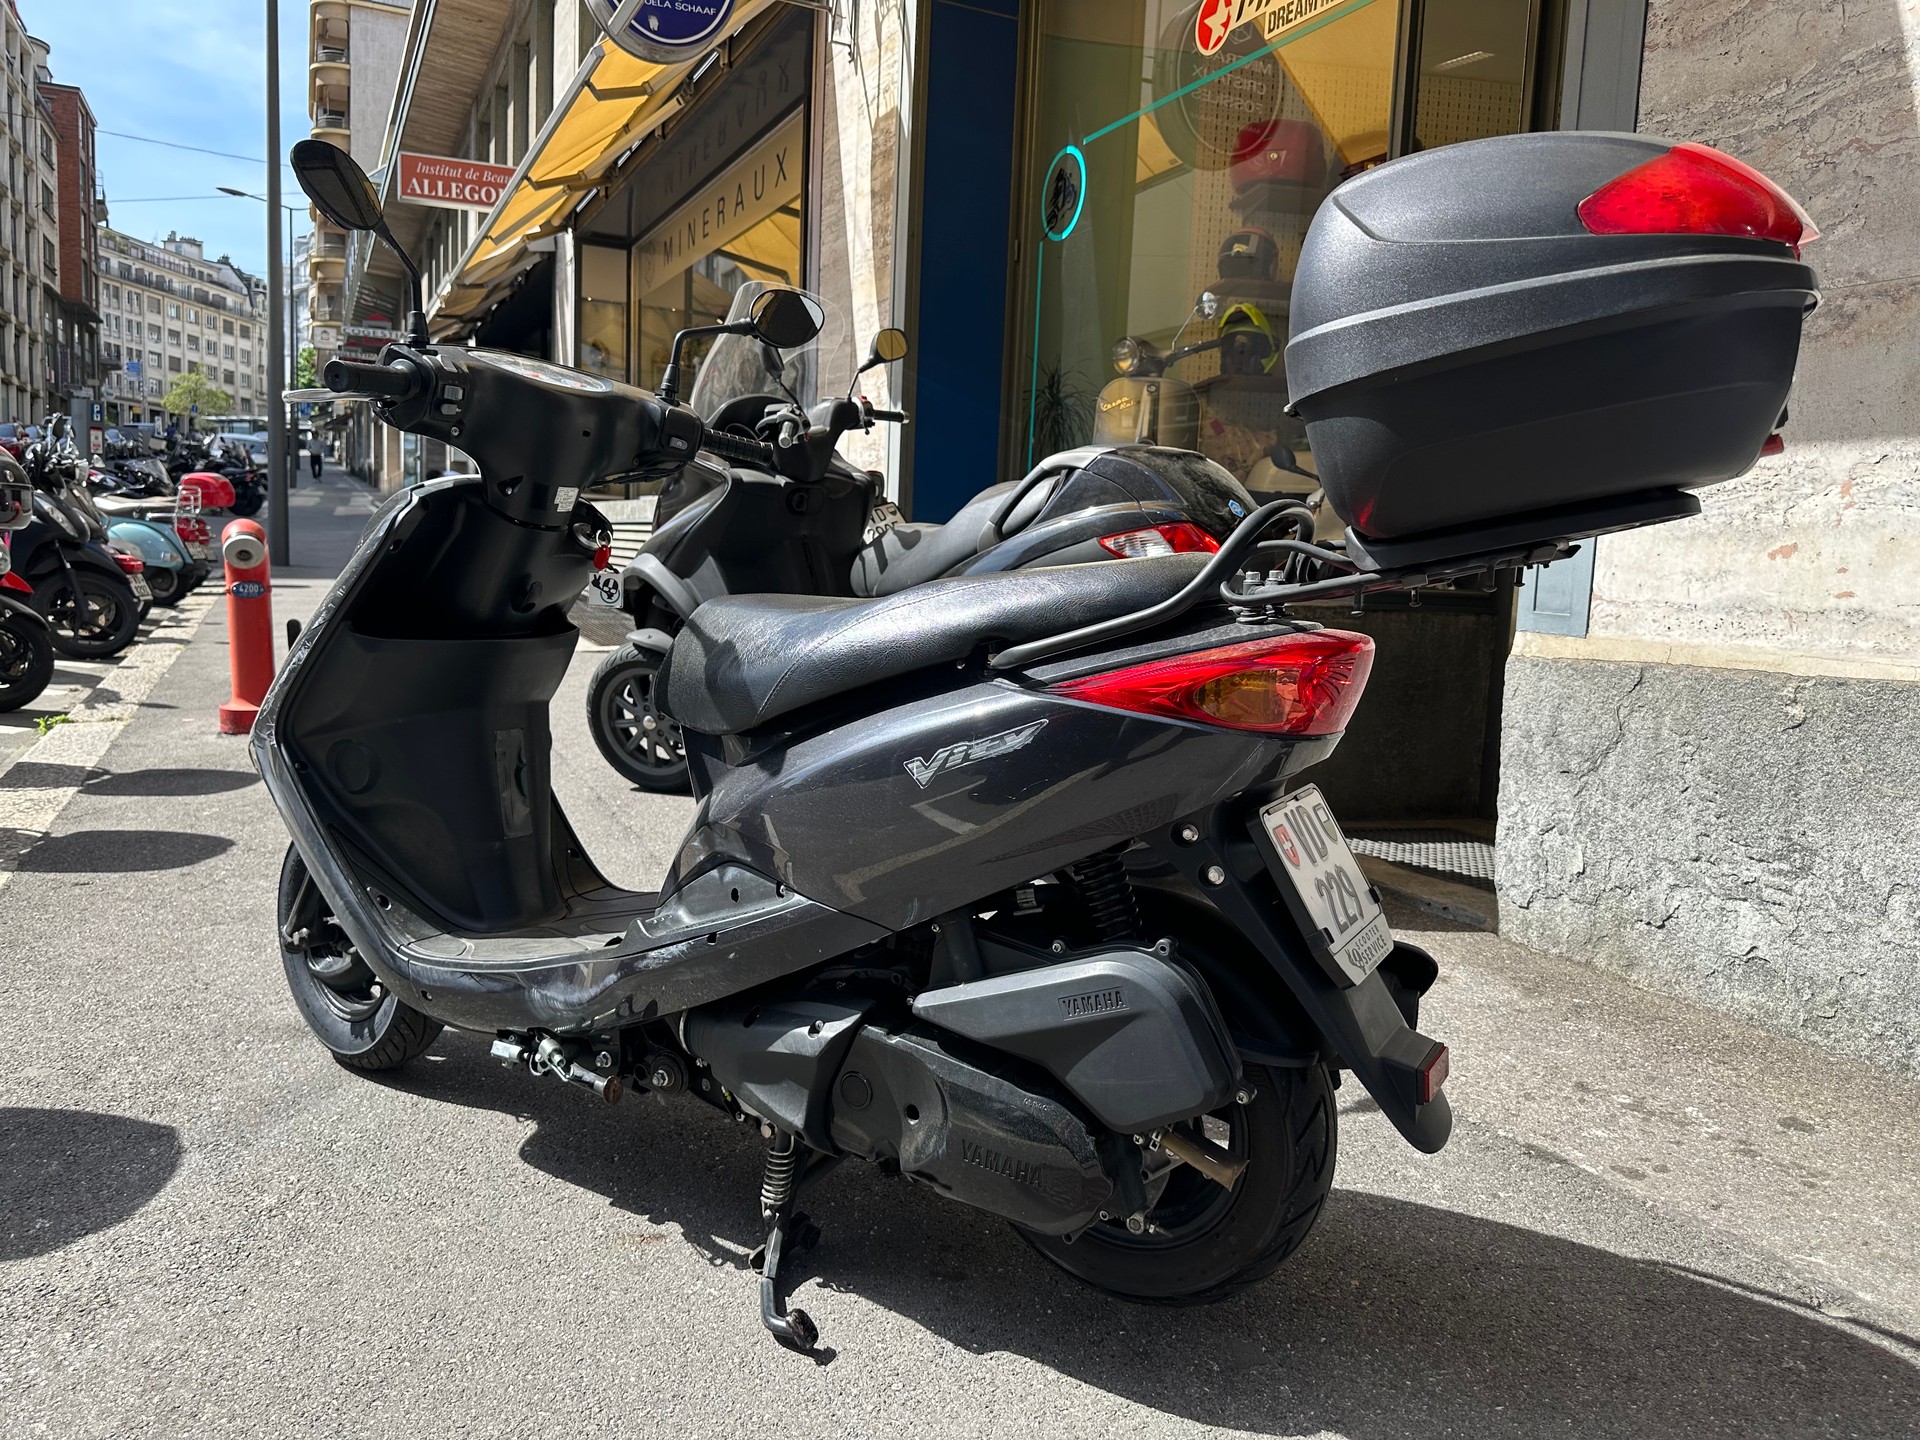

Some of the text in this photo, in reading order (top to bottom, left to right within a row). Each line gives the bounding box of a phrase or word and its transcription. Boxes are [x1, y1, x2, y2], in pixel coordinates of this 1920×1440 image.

[675, 2, 717, 16] SCHAAF
[1267, 0, 1318, 34] DREAM
[416, 162, 462, 178] Institut
[465, 168, 480, 181] de
[407, 177, 505, 204] ALLEGO
[663, 147, 788, 267] MINERAUX
[239, 583, 259, 593] 4200
[1284, 805, 1329, 866] VD
[1314, 864, 1365, 934] 229
[1355, 924, 1379, 950] SCOOTER
[1361, 934, 1387, 965] SERVICE
[1062, 991, 1127, 1017] YAMAHA
[961, 1139, 1046, 1190] YAMAHA
